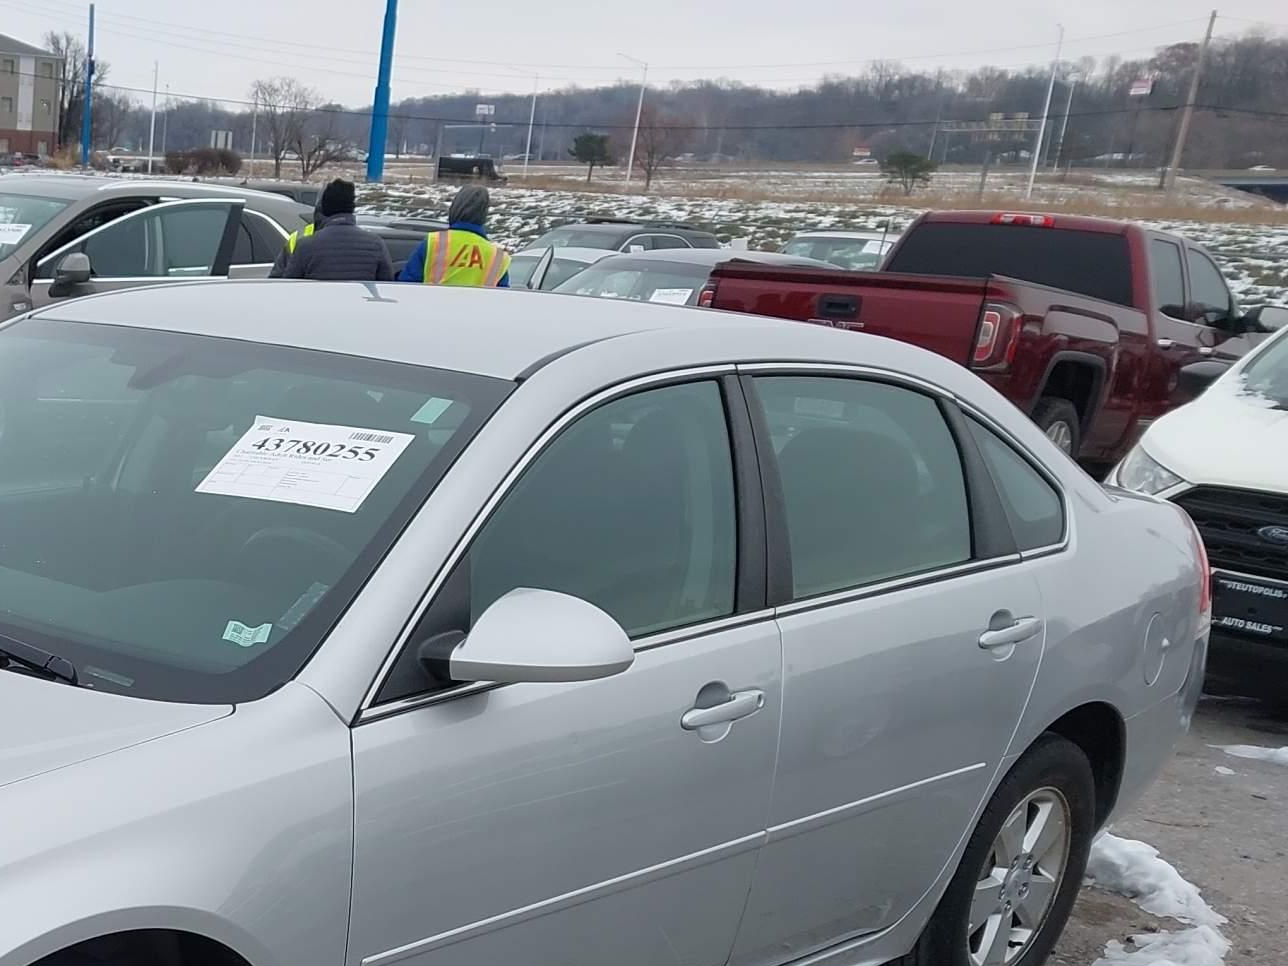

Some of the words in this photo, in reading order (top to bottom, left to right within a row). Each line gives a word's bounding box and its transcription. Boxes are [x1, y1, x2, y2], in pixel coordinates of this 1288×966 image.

[252, 437, 381, 462] 43780255
[1222, 616, 1245, 628] AUTO
[1246, 621, 1272, 634] SALES
